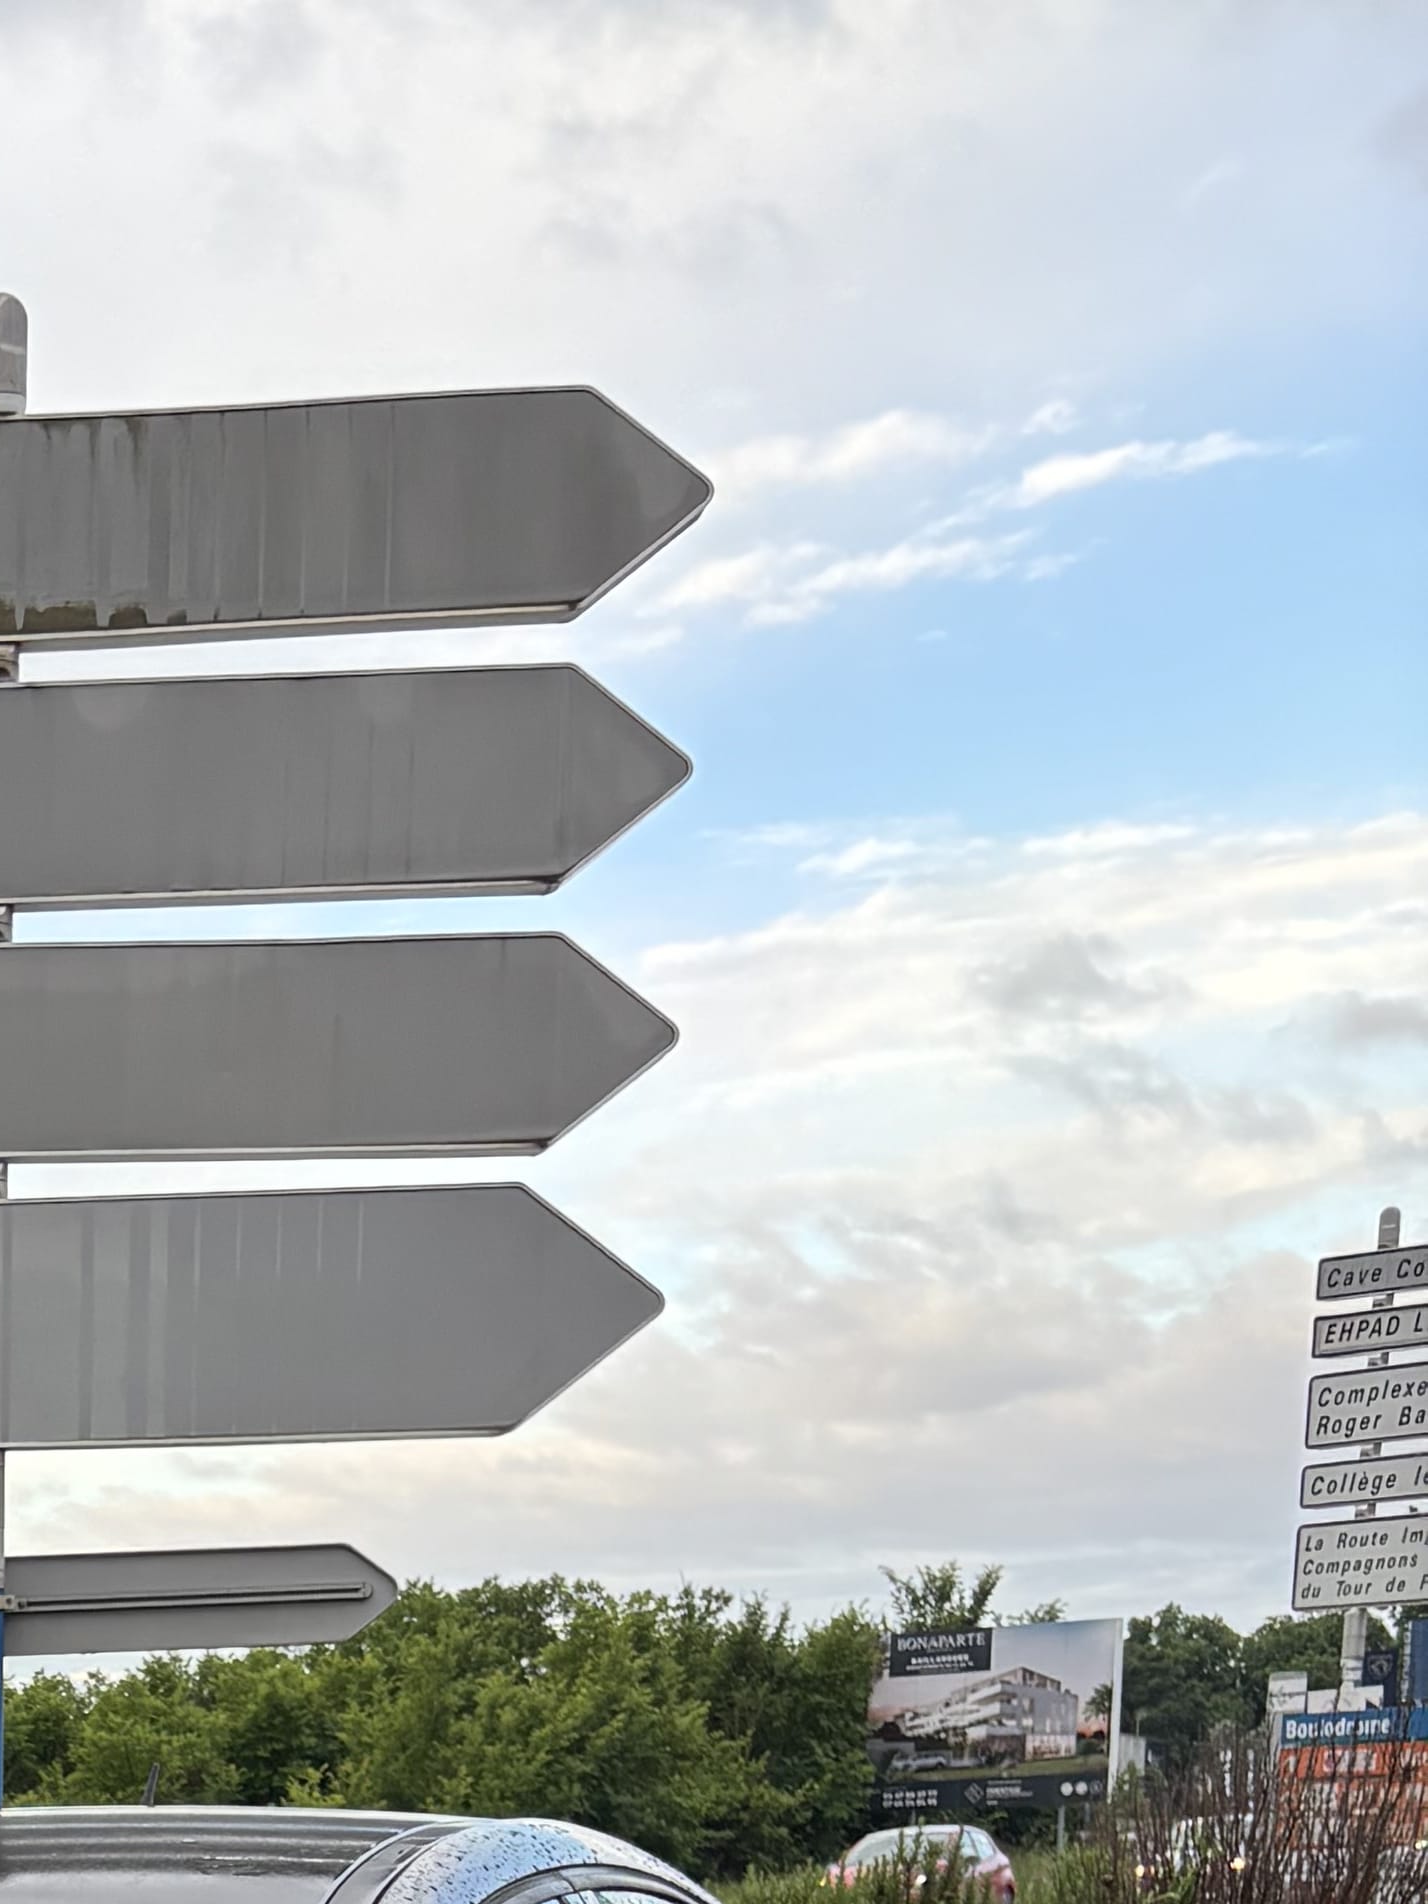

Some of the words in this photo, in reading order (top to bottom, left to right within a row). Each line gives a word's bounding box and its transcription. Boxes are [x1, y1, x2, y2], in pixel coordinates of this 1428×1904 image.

[1327, 1267, 1382, 1288] Cave
[1397, 1258, 1425, 1279] Co
[1324, 1315, 1400, 1344] EHPAD
[1317, 1379, 1428, 1408] Complexe
[1316, 1414, 1383, 1438] Roger
[1398, 1405, 1426, 1426] Ba
[1310, 1471, 1397, 1496] Collège
[1304, 1535, 1324, 1552] La
[1336, 1531, 1389, 1549] Route
[1302, 1553, 1418, 1577] Compagnons
[1300, 1583, 1322, 1600] du
[1336, 1580, 1373, 1598] Tour
[1385, 1576, 1407, 1593] de
[897, 1632, 986, 1652] BONAPARTE
